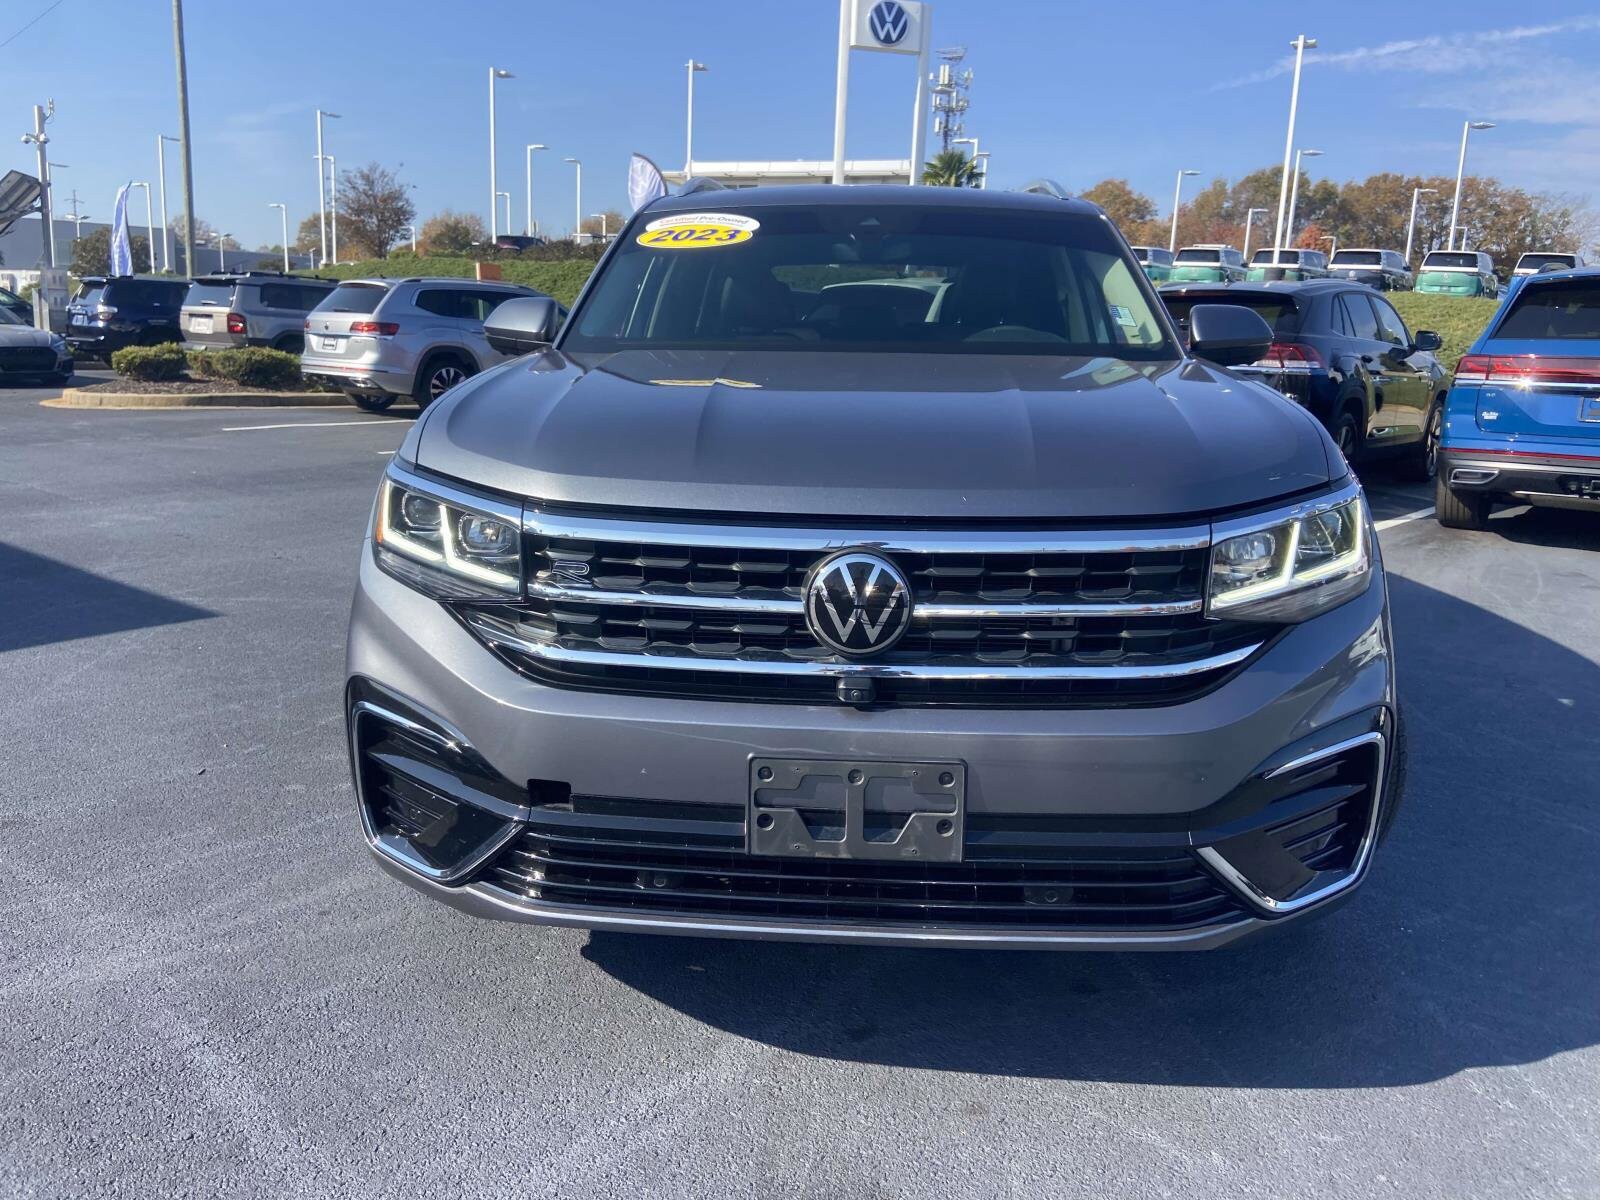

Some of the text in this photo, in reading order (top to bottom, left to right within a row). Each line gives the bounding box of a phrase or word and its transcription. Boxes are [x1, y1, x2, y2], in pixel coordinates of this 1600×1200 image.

[870, 1, 908, 44] VW
[647, 228, 741, 243] 2023
[810, 553, 910, 653] VW
